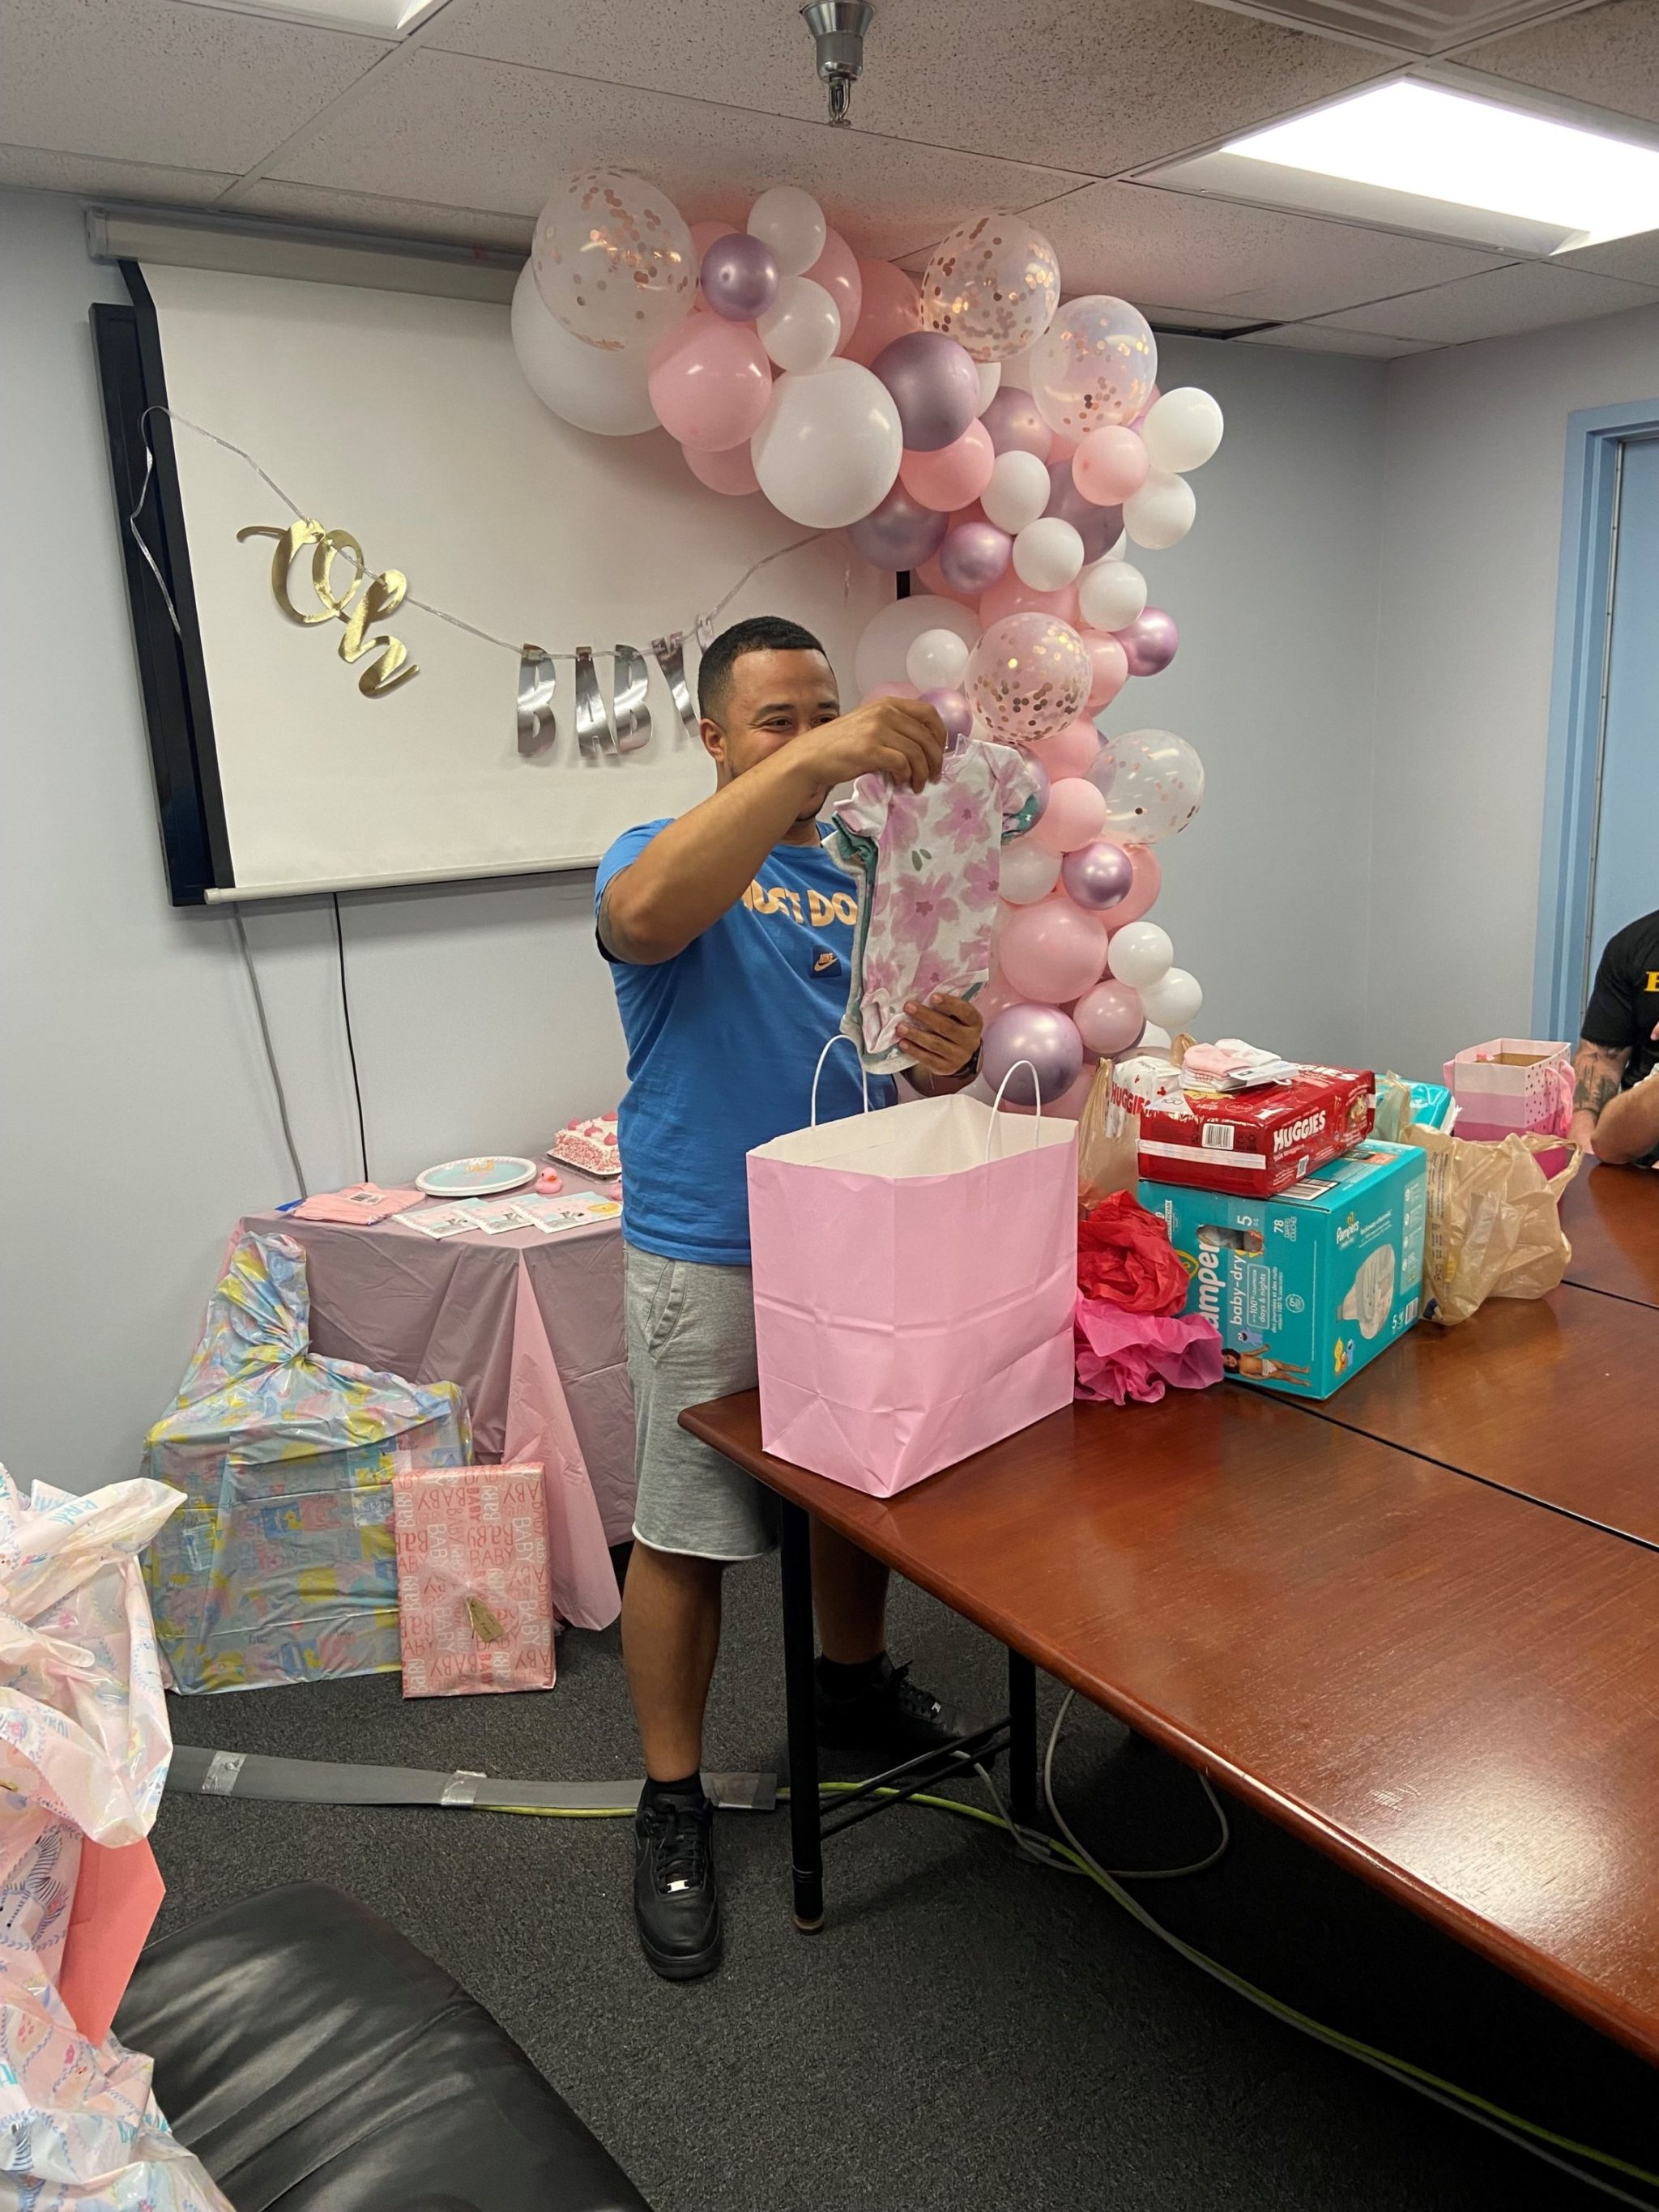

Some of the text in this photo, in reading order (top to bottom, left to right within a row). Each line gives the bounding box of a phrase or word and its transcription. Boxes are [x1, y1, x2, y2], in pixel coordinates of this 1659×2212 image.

[807, 889, 859, 927] DO
[819, 953, 834, 964] NIKE
[1273, 1110, 1326, 1153] HUGGIES
[1237, 1215, 1252, 1226] 5
[1273, 1219, 1284, 1234] 78
[1197, 1241, 1226, 1330] amper
[1230, 1255, 1247, 1325] baby-dry
[1258, 1273, 1267, 1294] nights
[1258, 1303, 1266, 1323] days
[513, 1517, 535, 1563] BABY
